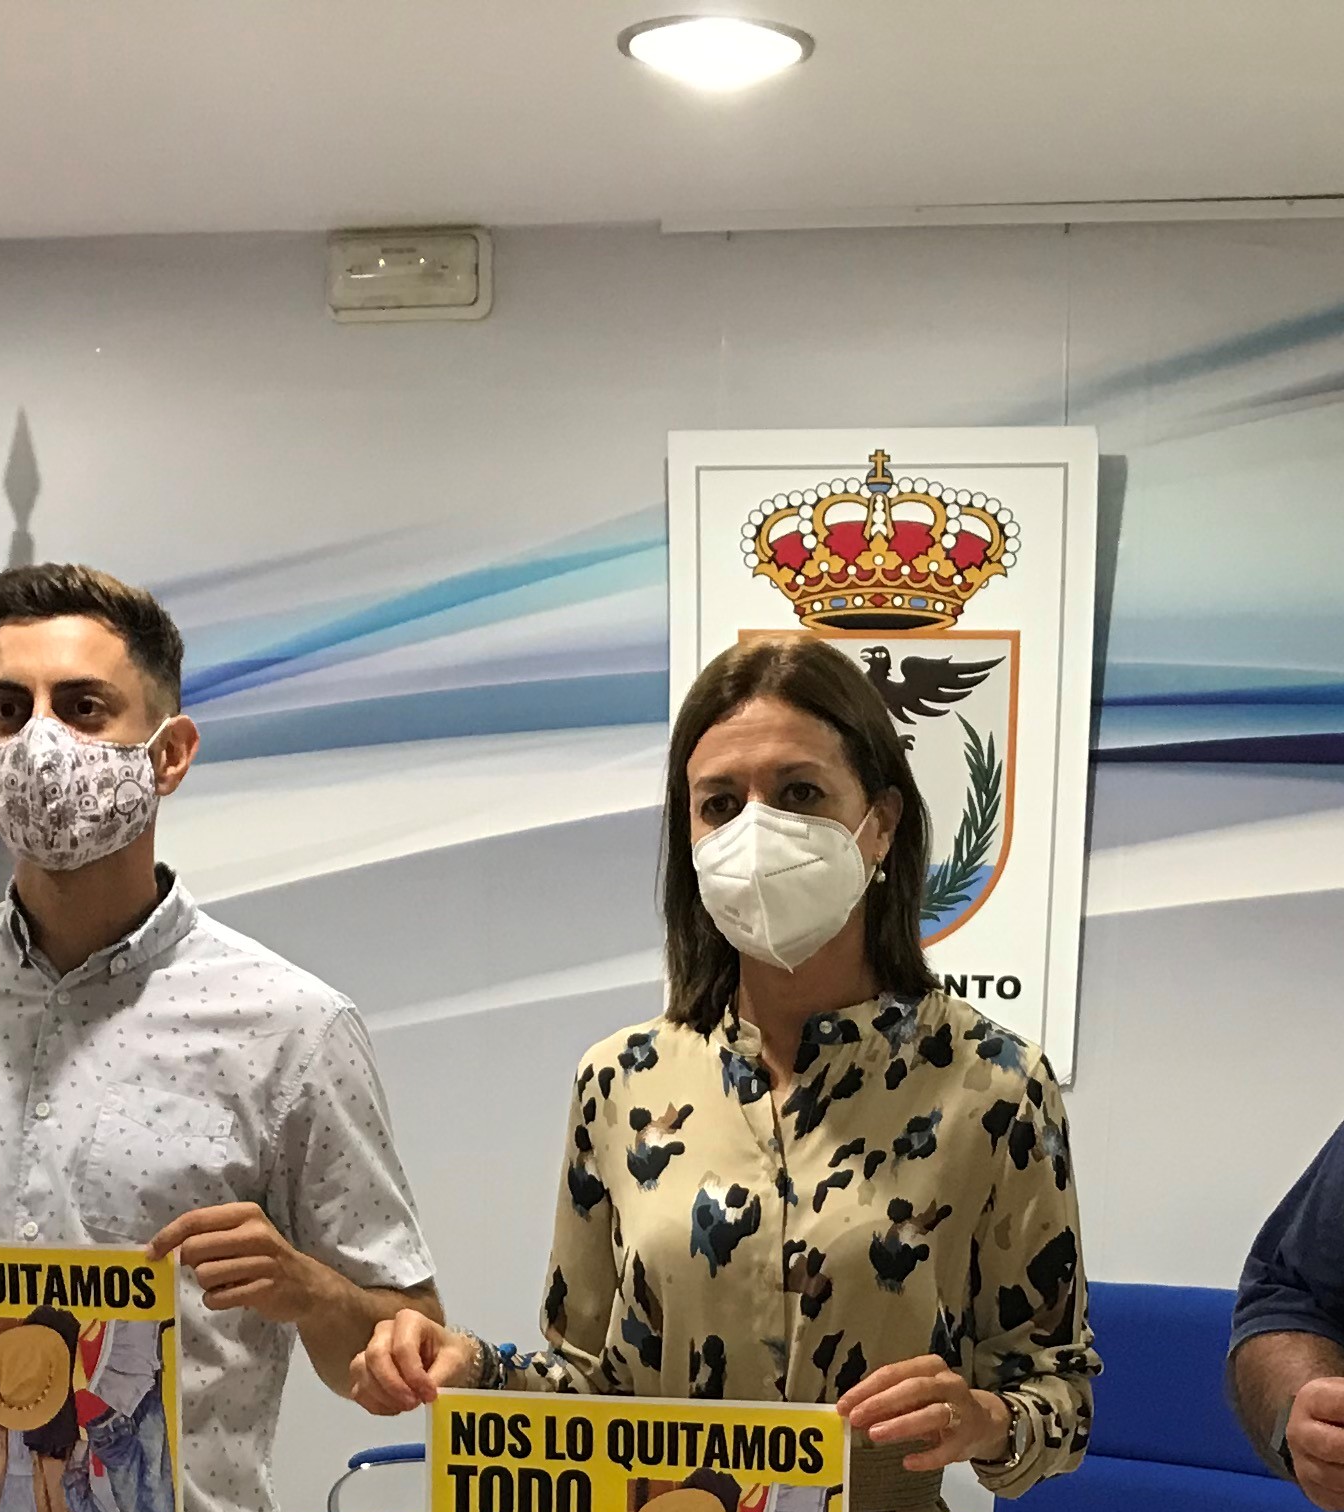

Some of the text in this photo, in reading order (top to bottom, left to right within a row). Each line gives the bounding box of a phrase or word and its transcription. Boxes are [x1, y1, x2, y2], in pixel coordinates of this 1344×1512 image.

[943, 974, 1022, 1000] NTO
[451, 1411, 824, 1473] NOS LO QUITAMOS
